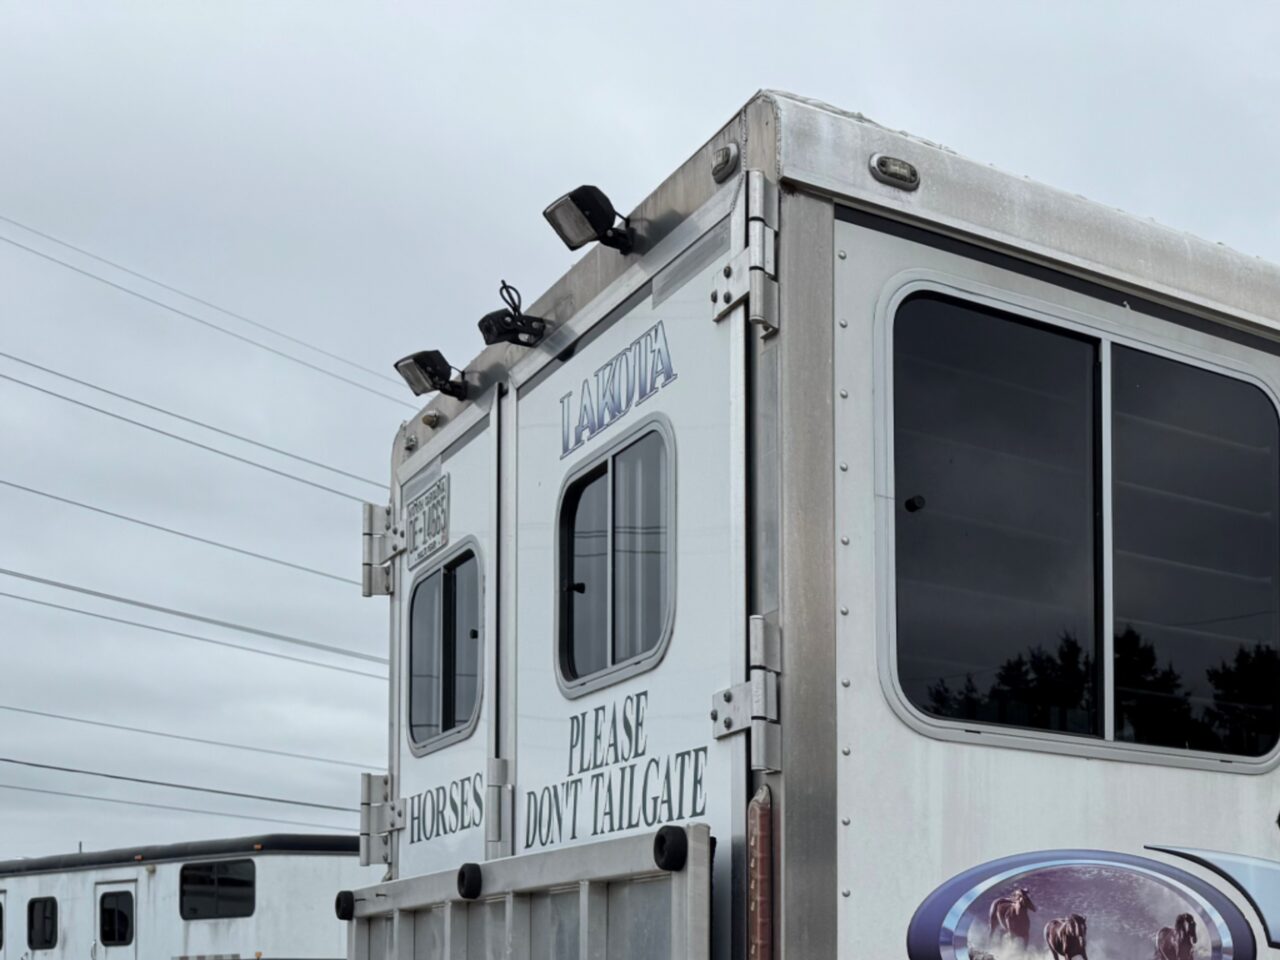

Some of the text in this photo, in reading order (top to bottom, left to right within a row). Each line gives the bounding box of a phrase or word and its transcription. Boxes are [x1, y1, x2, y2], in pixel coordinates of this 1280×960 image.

[560, 320, 678, 459] LAKOTA
[569, 690, 649, 776] PLEASE
[409, 772, 484, 844] HORSES
[525, 746, 708, 849] DON'T TAILGATE
